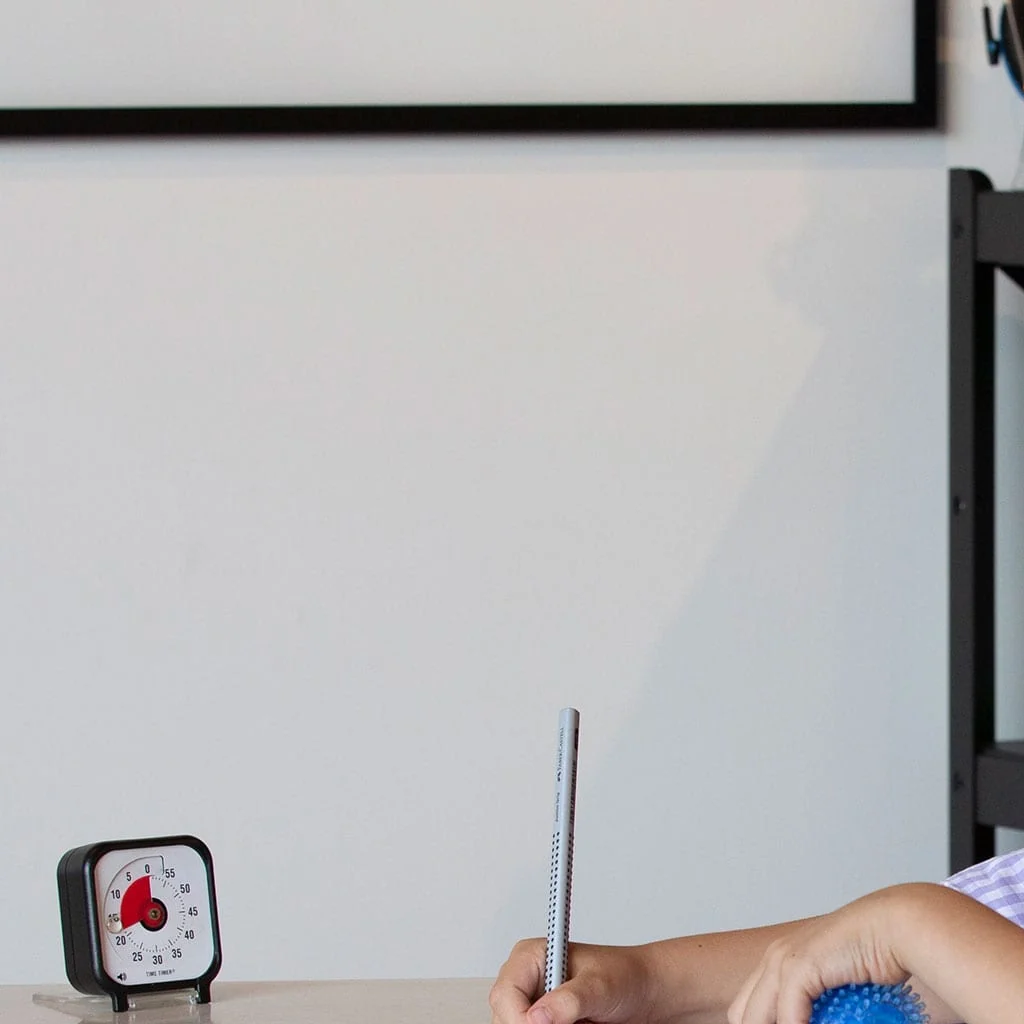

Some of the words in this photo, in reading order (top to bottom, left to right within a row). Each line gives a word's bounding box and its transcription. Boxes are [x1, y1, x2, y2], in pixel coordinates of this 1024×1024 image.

[144, 864, 150, 874] 0
[165, 868, 175, 878] 55
[126, 872, 132, 881] 5
[180, 883, 190, 893] 50
[111, 889, 121, 899] 10
[188, 906, 198, 917] 45
[184, 930, 194, 939] 40
[116, 935, 126, 946] 20
[132, 952, 143, 961] 25
[171, 948, 182, 958] 35
[152, 956, 163, 965] 30
